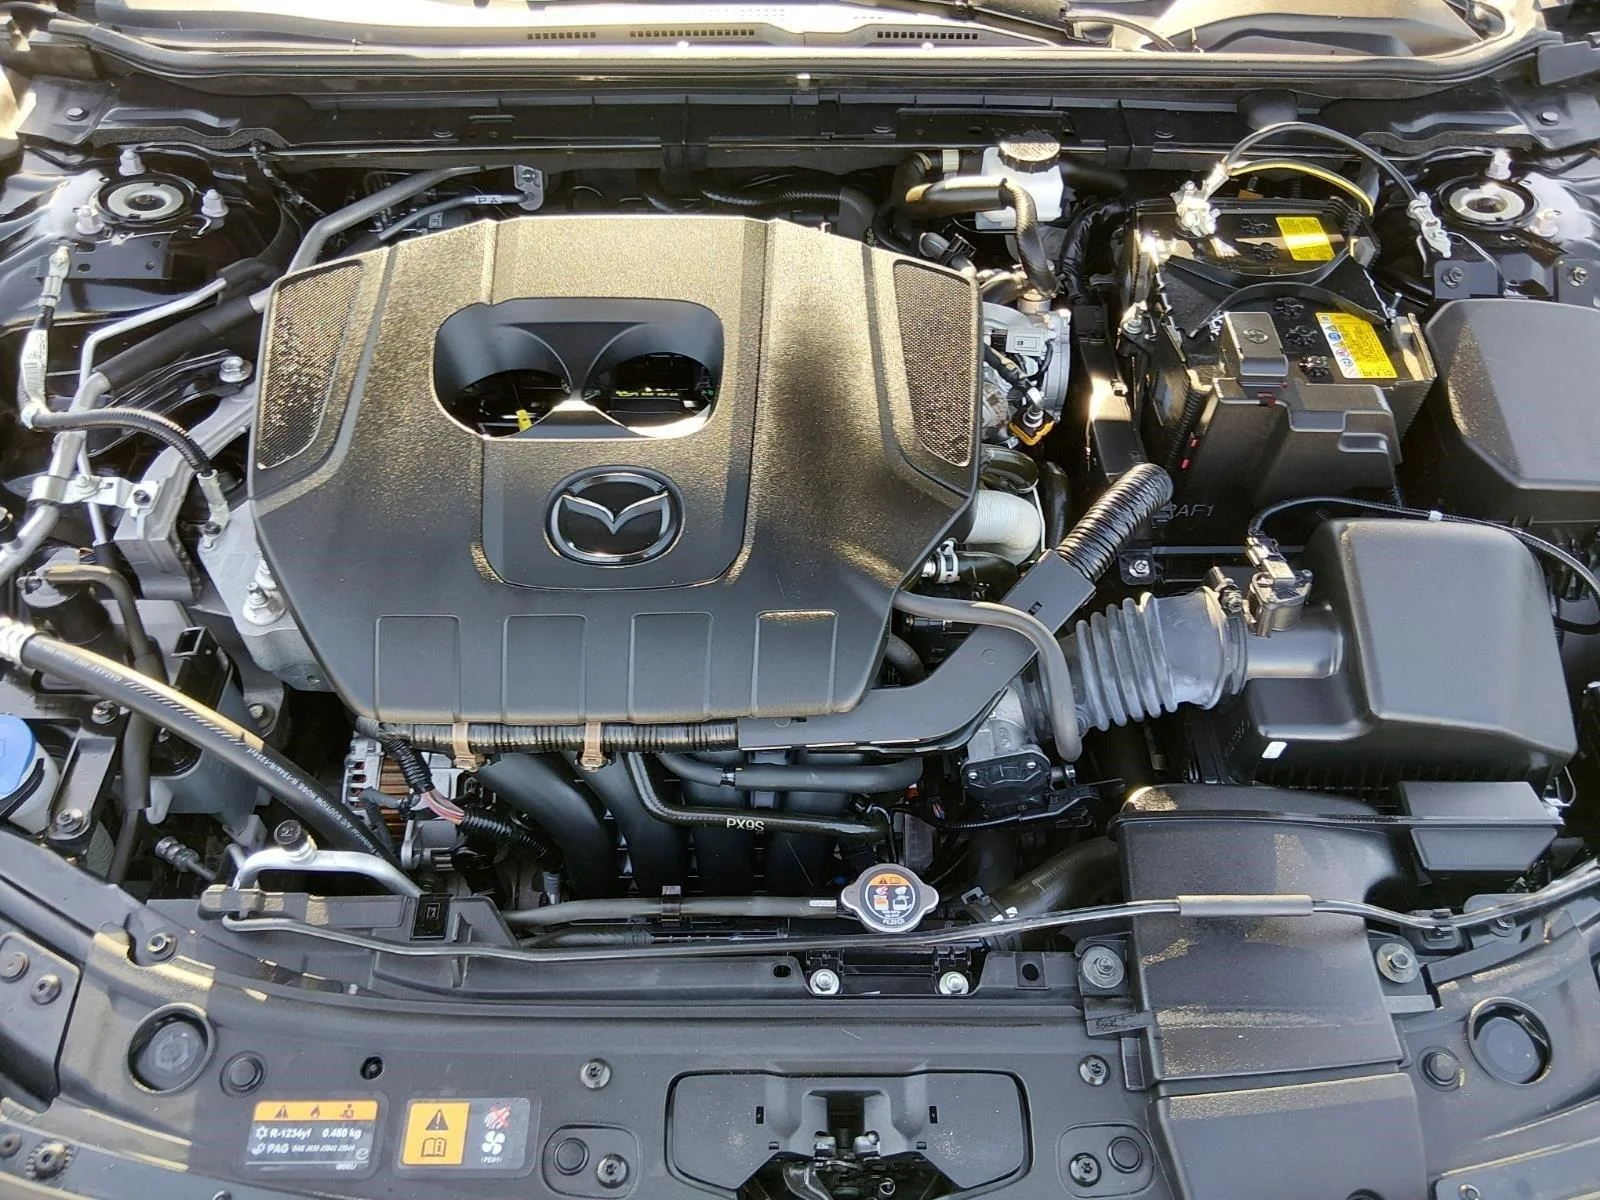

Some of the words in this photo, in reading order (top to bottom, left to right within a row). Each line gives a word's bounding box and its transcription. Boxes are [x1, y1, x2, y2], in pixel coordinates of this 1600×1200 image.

[297, 782, 317, 799] HOSE
[315, 797, 342, 820] SUCTION
[726, 817, 765, 831] PX9S
[269, 1127, 312, 1140] R-1234yf
[349, 1127, 362, 1140] kg
[266, 1143, 289, 1153] PAG
